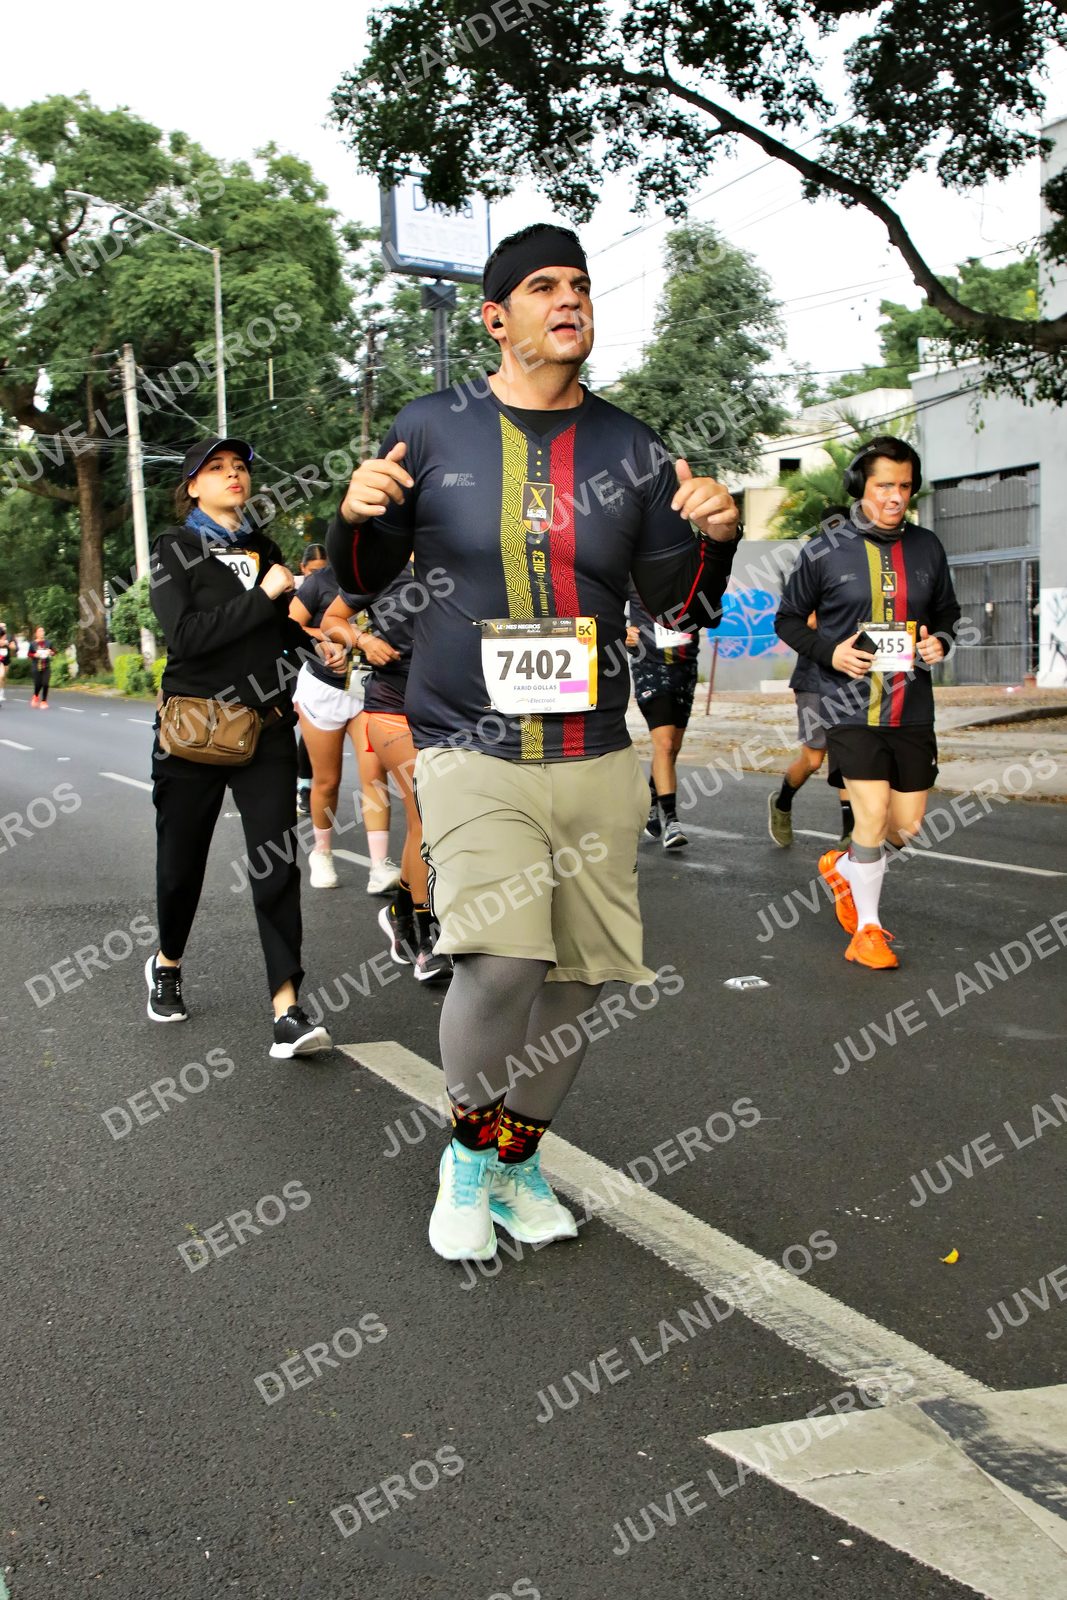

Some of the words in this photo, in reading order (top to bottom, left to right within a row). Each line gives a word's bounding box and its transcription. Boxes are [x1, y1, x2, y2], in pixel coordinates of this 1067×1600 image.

[578, 625, 592, 636] 5K
[877, 638, 905, 653] 455
[497, 649, 572, 681] 7402
